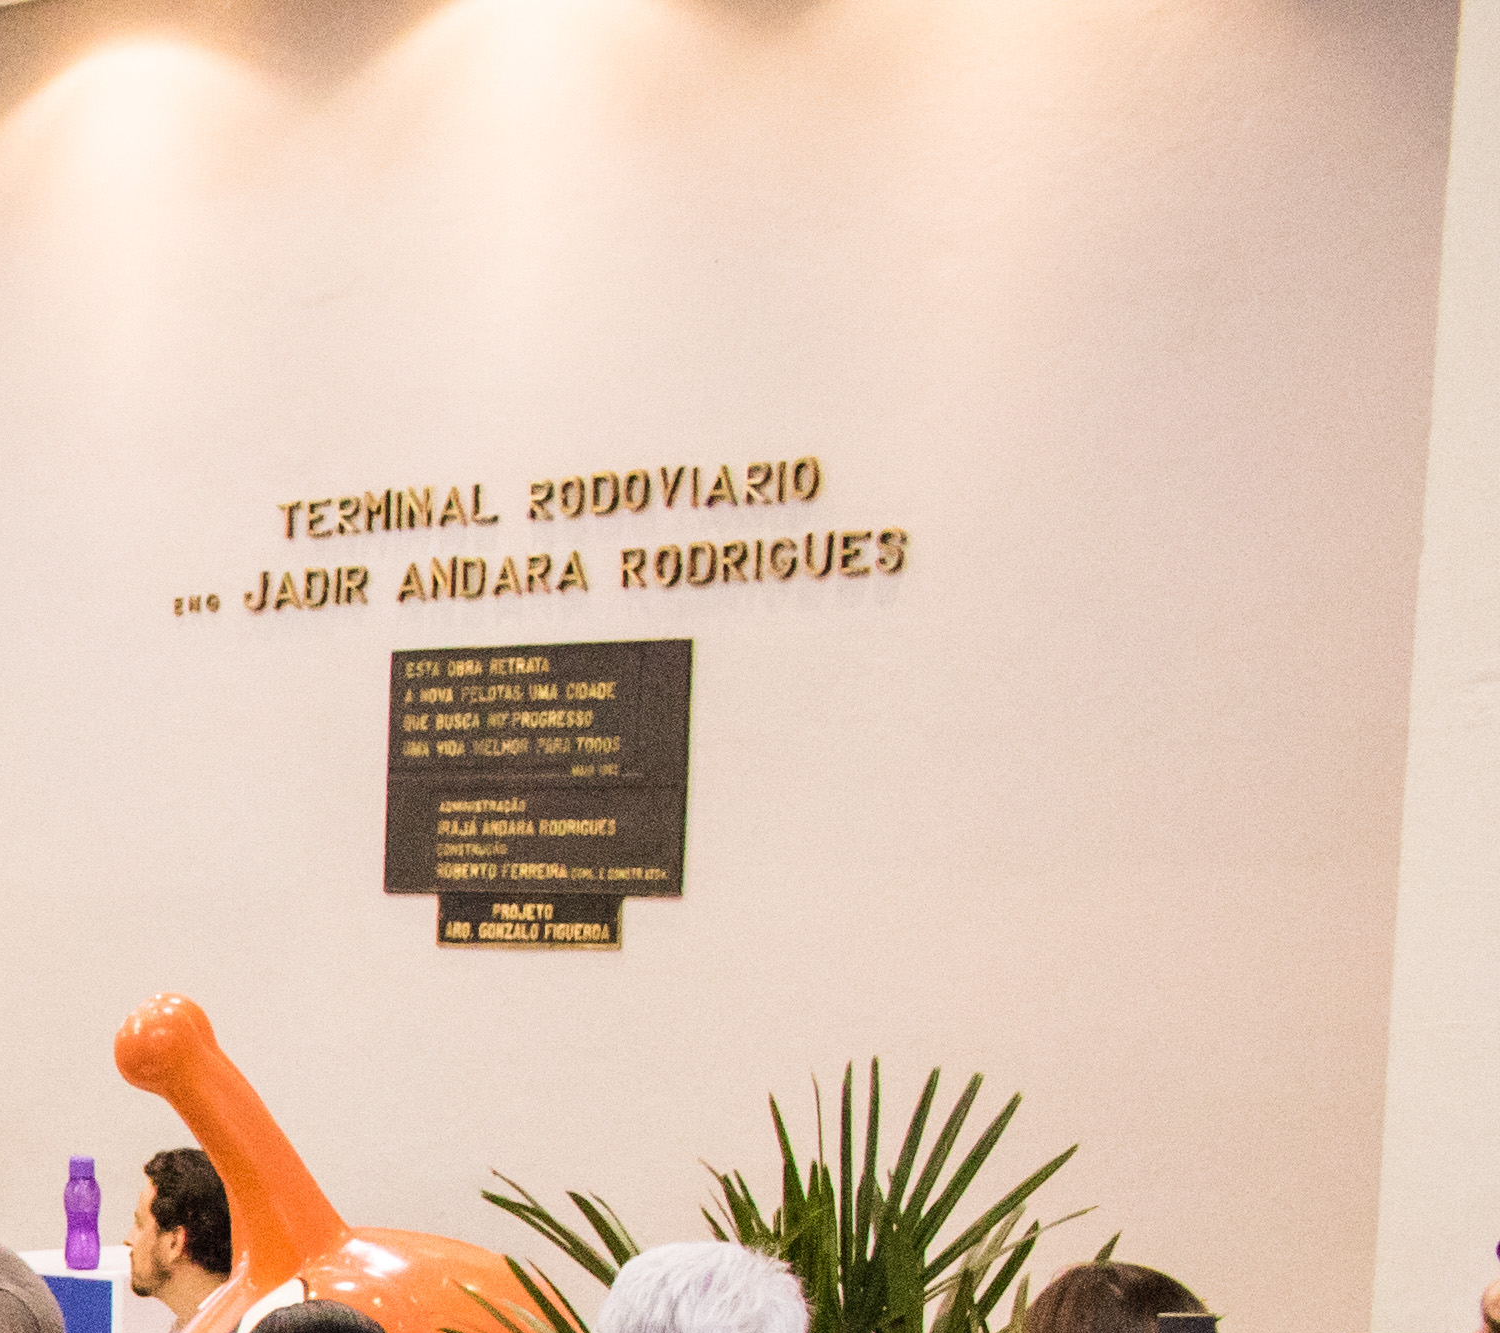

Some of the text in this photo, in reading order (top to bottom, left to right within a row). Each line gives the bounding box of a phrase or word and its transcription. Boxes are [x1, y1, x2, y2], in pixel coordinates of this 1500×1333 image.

[277, 455, 823, 540] TERMINAL RODOVIARIO
[243, 565, 369, 615] JADIR
[397, 550, 589, 604] ANDARA
[620, 526, 909, 590] RODRIGUES
[491, 902, 554, 921] PROJETO
